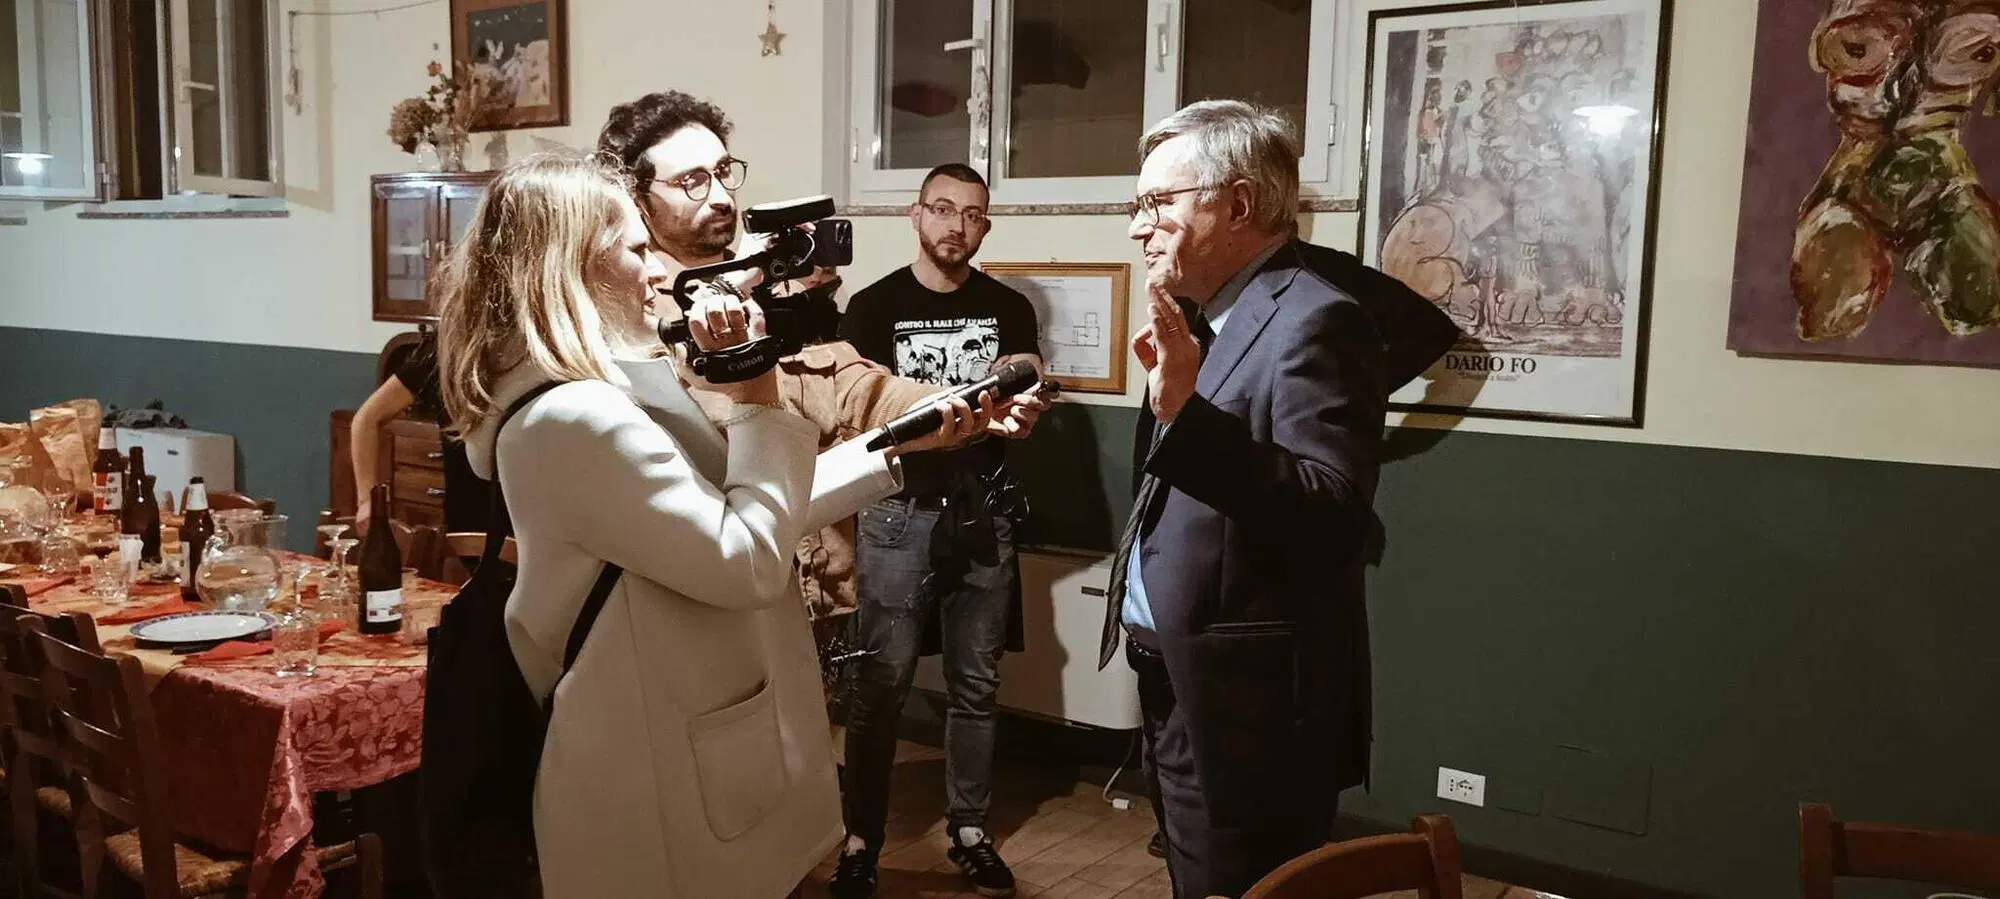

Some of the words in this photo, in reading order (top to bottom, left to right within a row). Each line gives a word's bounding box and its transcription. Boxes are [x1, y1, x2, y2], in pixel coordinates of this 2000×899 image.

[894, 320, 924, 330] CONTRO
[925, 320, 932, 328] IL
[933, 319, 953, 328] MALE
[953, 318, 965, 327] CHE
[966, 317, 998, 327] AVANZA
[727, 354, 764, 371] Canon
[1445, 354, 1504, 372] DARIO
[1510, 357, 1537, 374] FO
